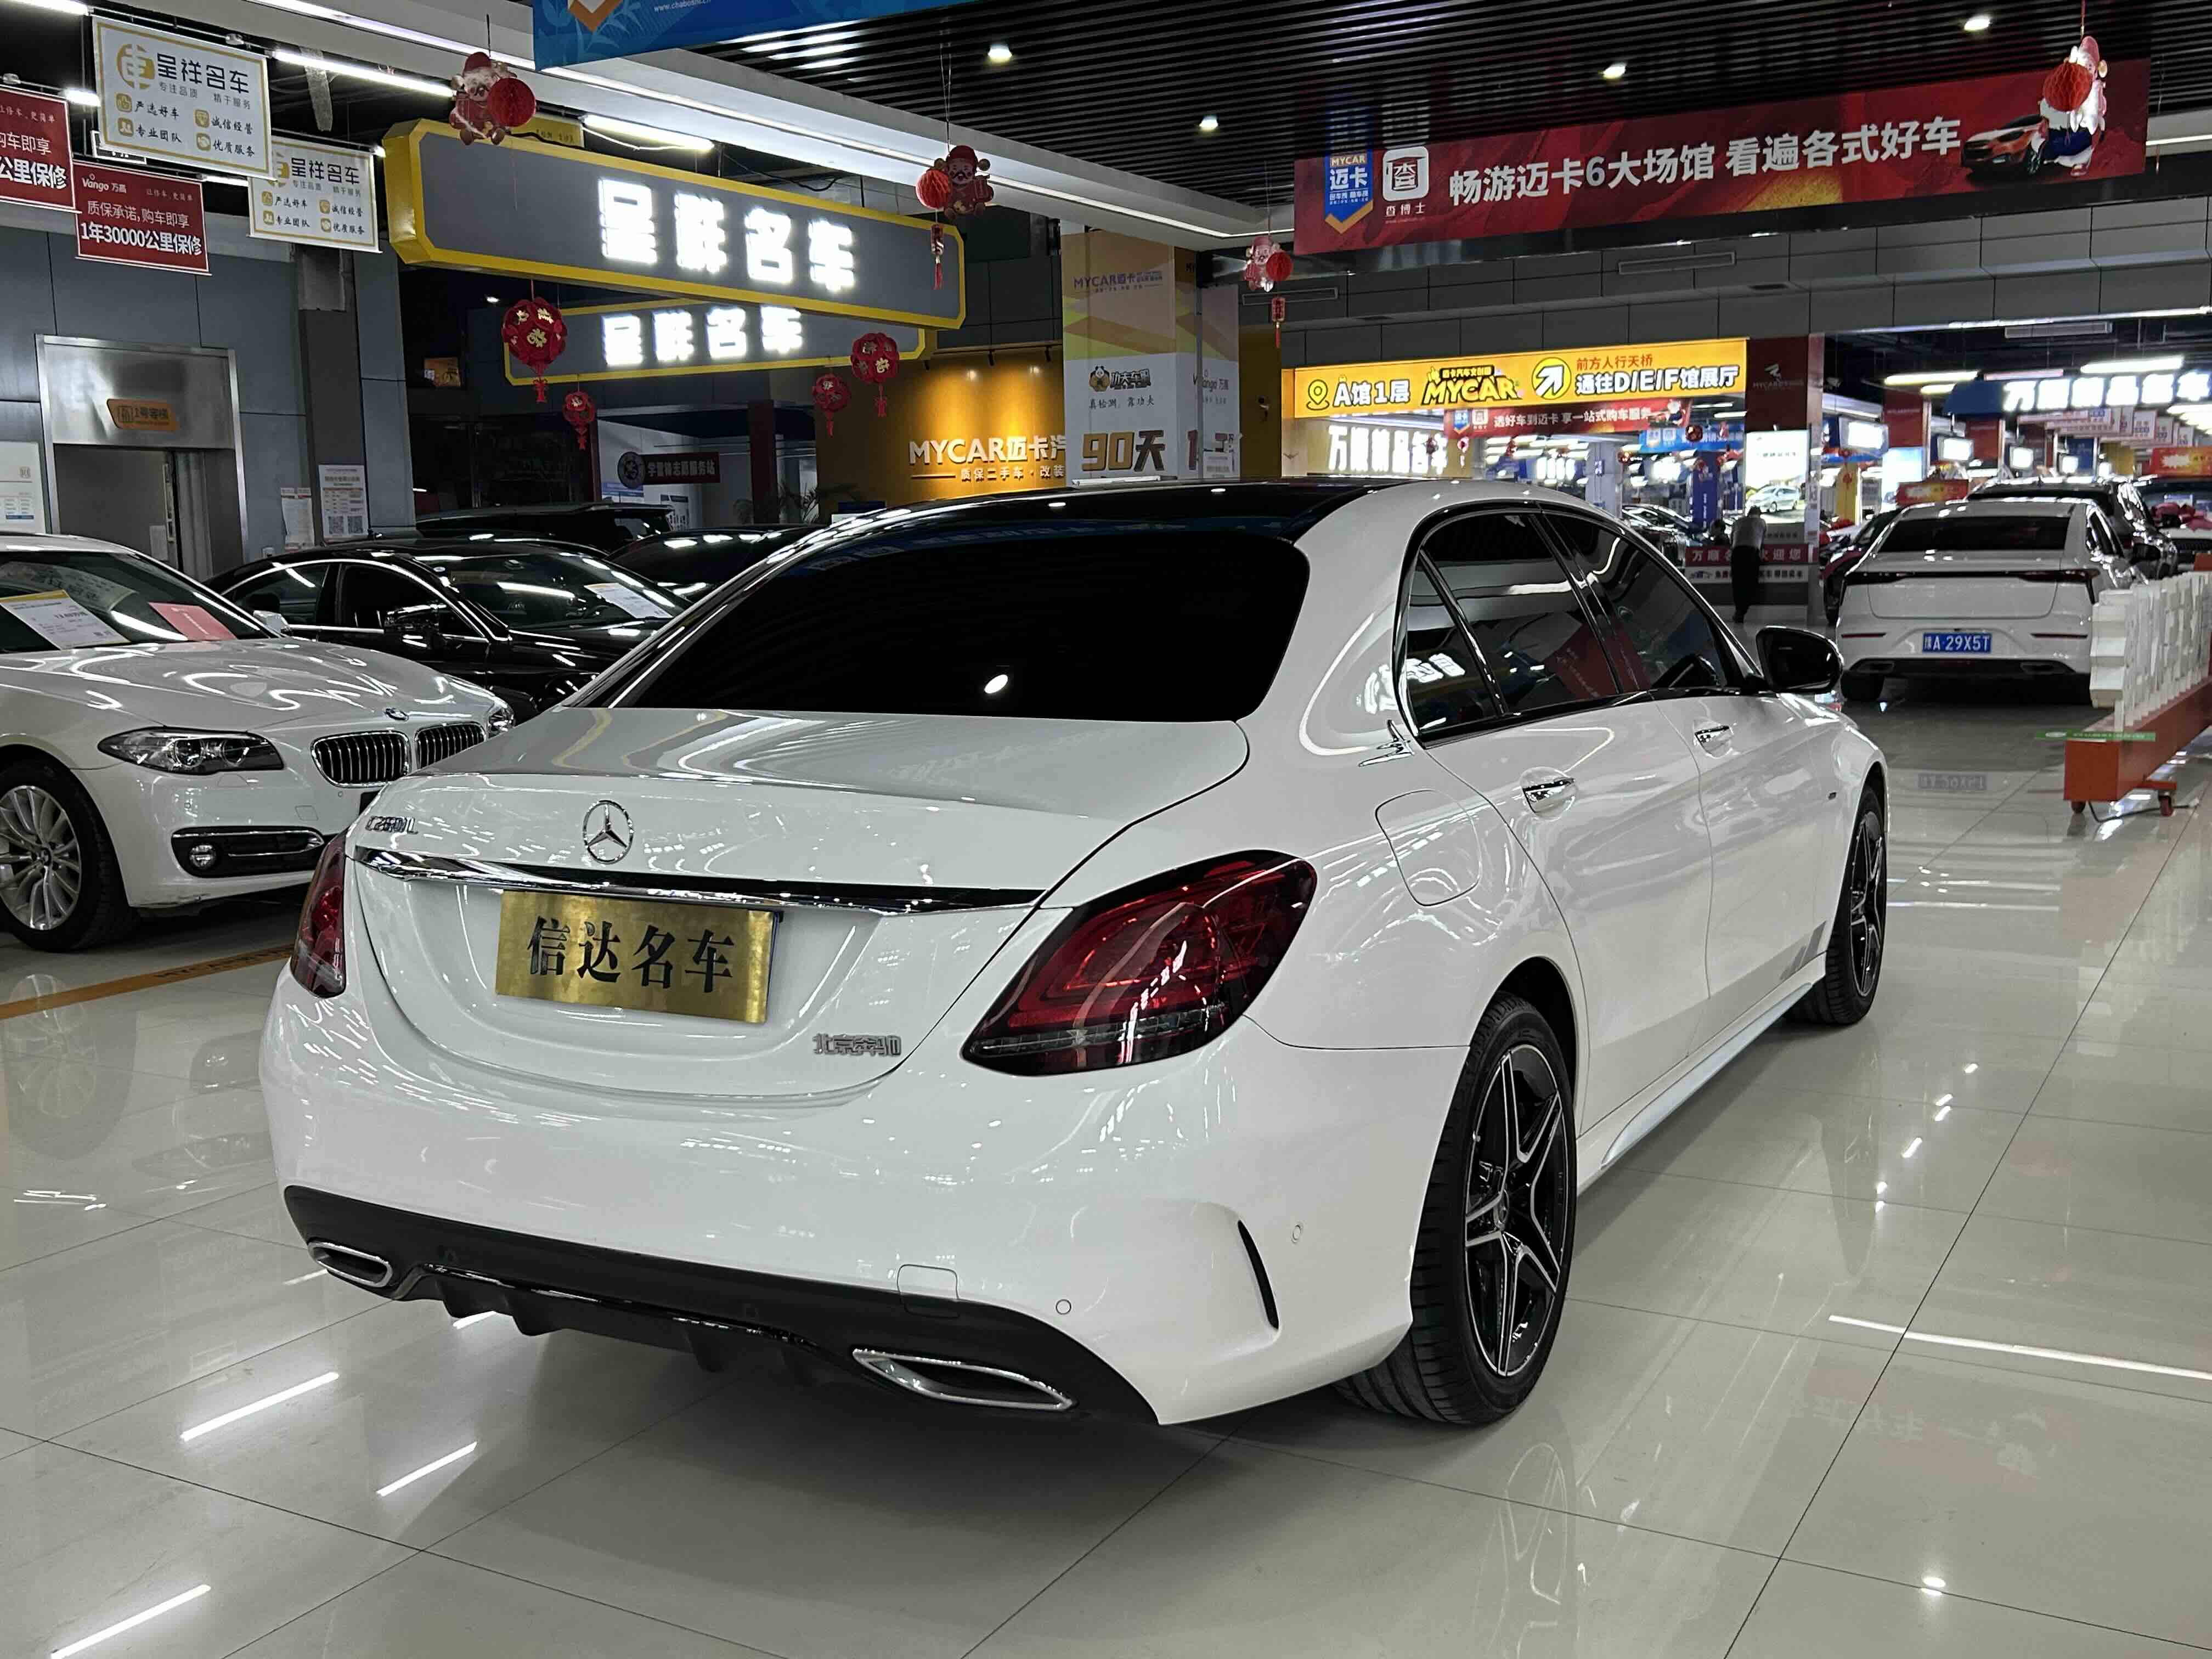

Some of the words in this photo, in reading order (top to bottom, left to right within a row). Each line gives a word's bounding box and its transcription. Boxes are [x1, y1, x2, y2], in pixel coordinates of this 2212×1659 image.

[157, 53, 249, 94] 呈祥名车
[134, 101, 179, 119] 严选好车
[136, 125, 182, 143] 专业团队
[212, 139, 255, 158] 优质服务
[291, 157, 360, 185] 呈祥名车
[1331, 154, 1366, 167] MYCAR
[1449, 141, 1716, 206] 畅游迈卡6大场馆
[1725, 115, 1962, 178] 看遍各式好车
[1330, 166, 1368, 191] 迈卡
[81, 221, 202, 256] 1年30000公里保修
[1576, 353, 1654, 371] 前方人行天桥
[1421, 375, 1518, 406] MYCAR
[1575, 365, 1740, 396] 通往D/E/F馆展厅
[1081, 430, 1166, 472] 90天
[527, 915, 735, 994] 信达名车
